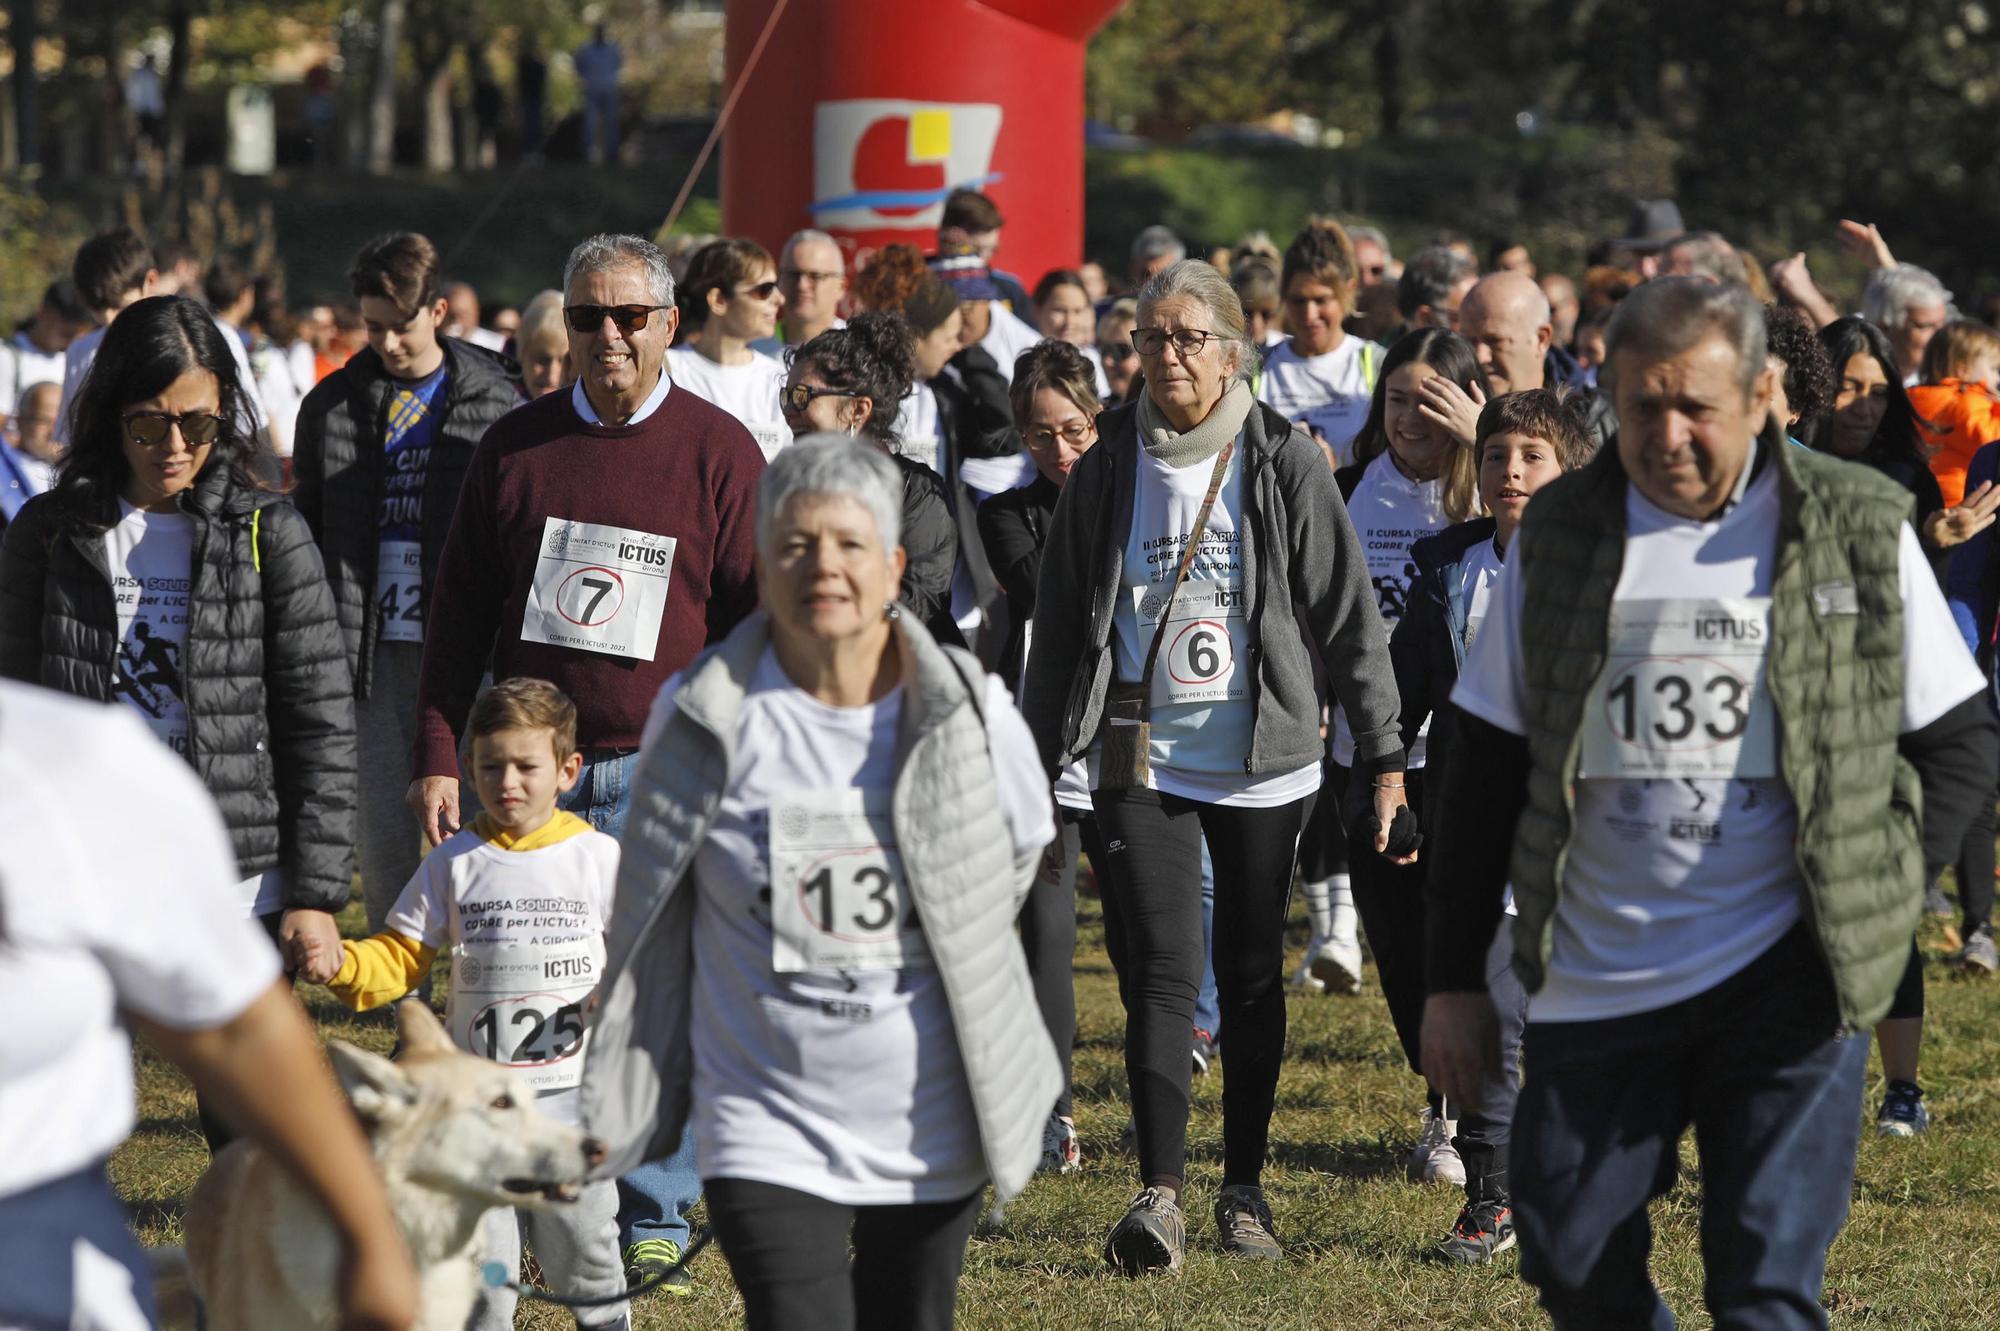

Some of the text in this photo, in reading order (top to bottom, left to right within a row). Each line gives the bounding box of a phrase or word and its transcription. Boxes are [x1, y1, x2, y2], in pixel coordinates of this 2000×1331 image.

[1376, 529, 1412, 537] CURSA
[570, 536, 616, 550] UNITAT D'ICTUS
[1368, 541, 1403, 550] CORRE
[618, 542, 667, 566] ICTUS
[642, 565, 665, 574] Girona
[1202, 563, 1239, 571] GIRONA
[139, 595, 159, 607] per
[581, 577, 613, 625] 7
[160, 614, 168, 624] A
[1694, 618, 1761, 640] ICTUS
[549, 633, 626, 652] CORRE PER L'ICTUS! 2022
[1187, 631, 1219, 677] 6
[1168, 692, 1187, 701] CORRE
[1189, 691, 1200, 699] PER
[1609, 675, 1748, 741] 133
[470, 900, 513, 914] CURSA
[515, 897, 590, 916] SOLIDÀRIA
[804, 866, 894, 932] 13
[465, 916, 503, 931] CORRE
[507, 917, 529, 929] per
[533, 916, 579, 928] L'ICTUS
[530, 936, 539, 945] A
[544, 956, 592, 979] ICTUS
[475, 1004, 584, 1063] 125
